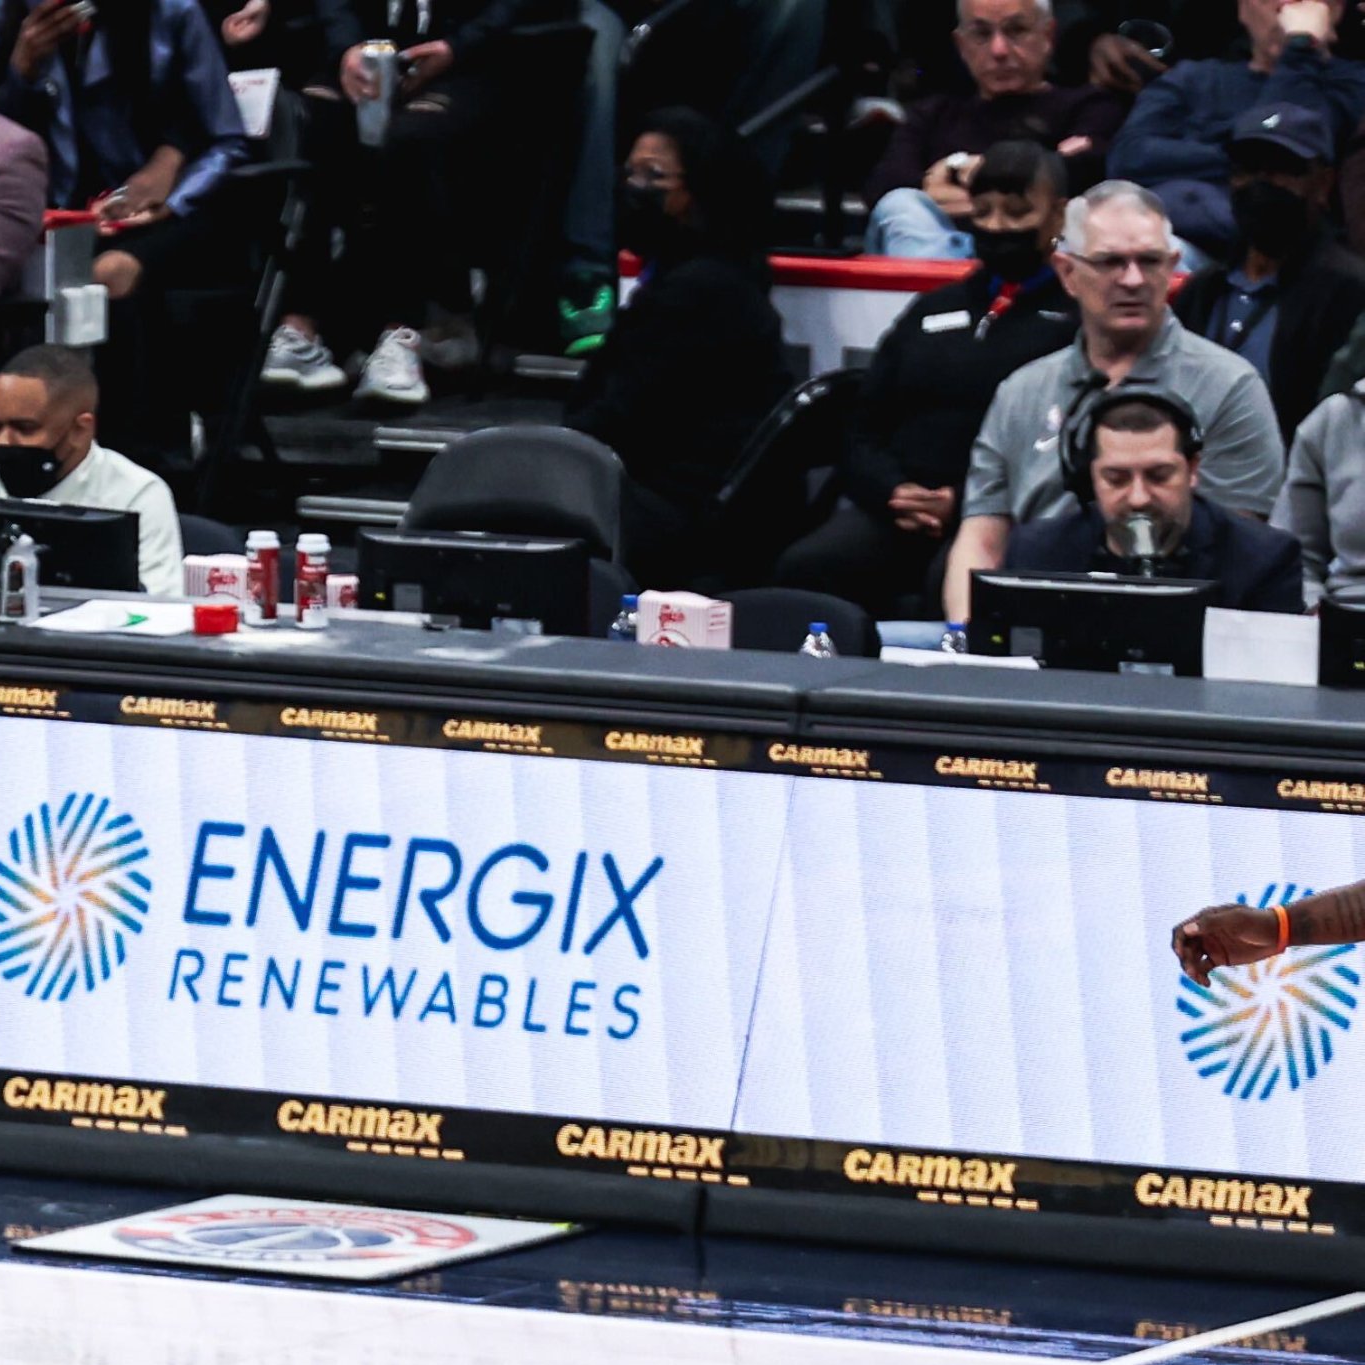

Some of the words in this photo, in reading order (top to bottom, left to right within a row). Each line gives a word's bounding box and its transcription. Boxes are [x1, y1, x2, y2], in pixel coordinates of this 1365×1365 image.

[1276, 779, 1365, 802] CARma
[182, 820, 665, 960] ENERGIX
[168, 948, 643, 1041] RENEWABLES
